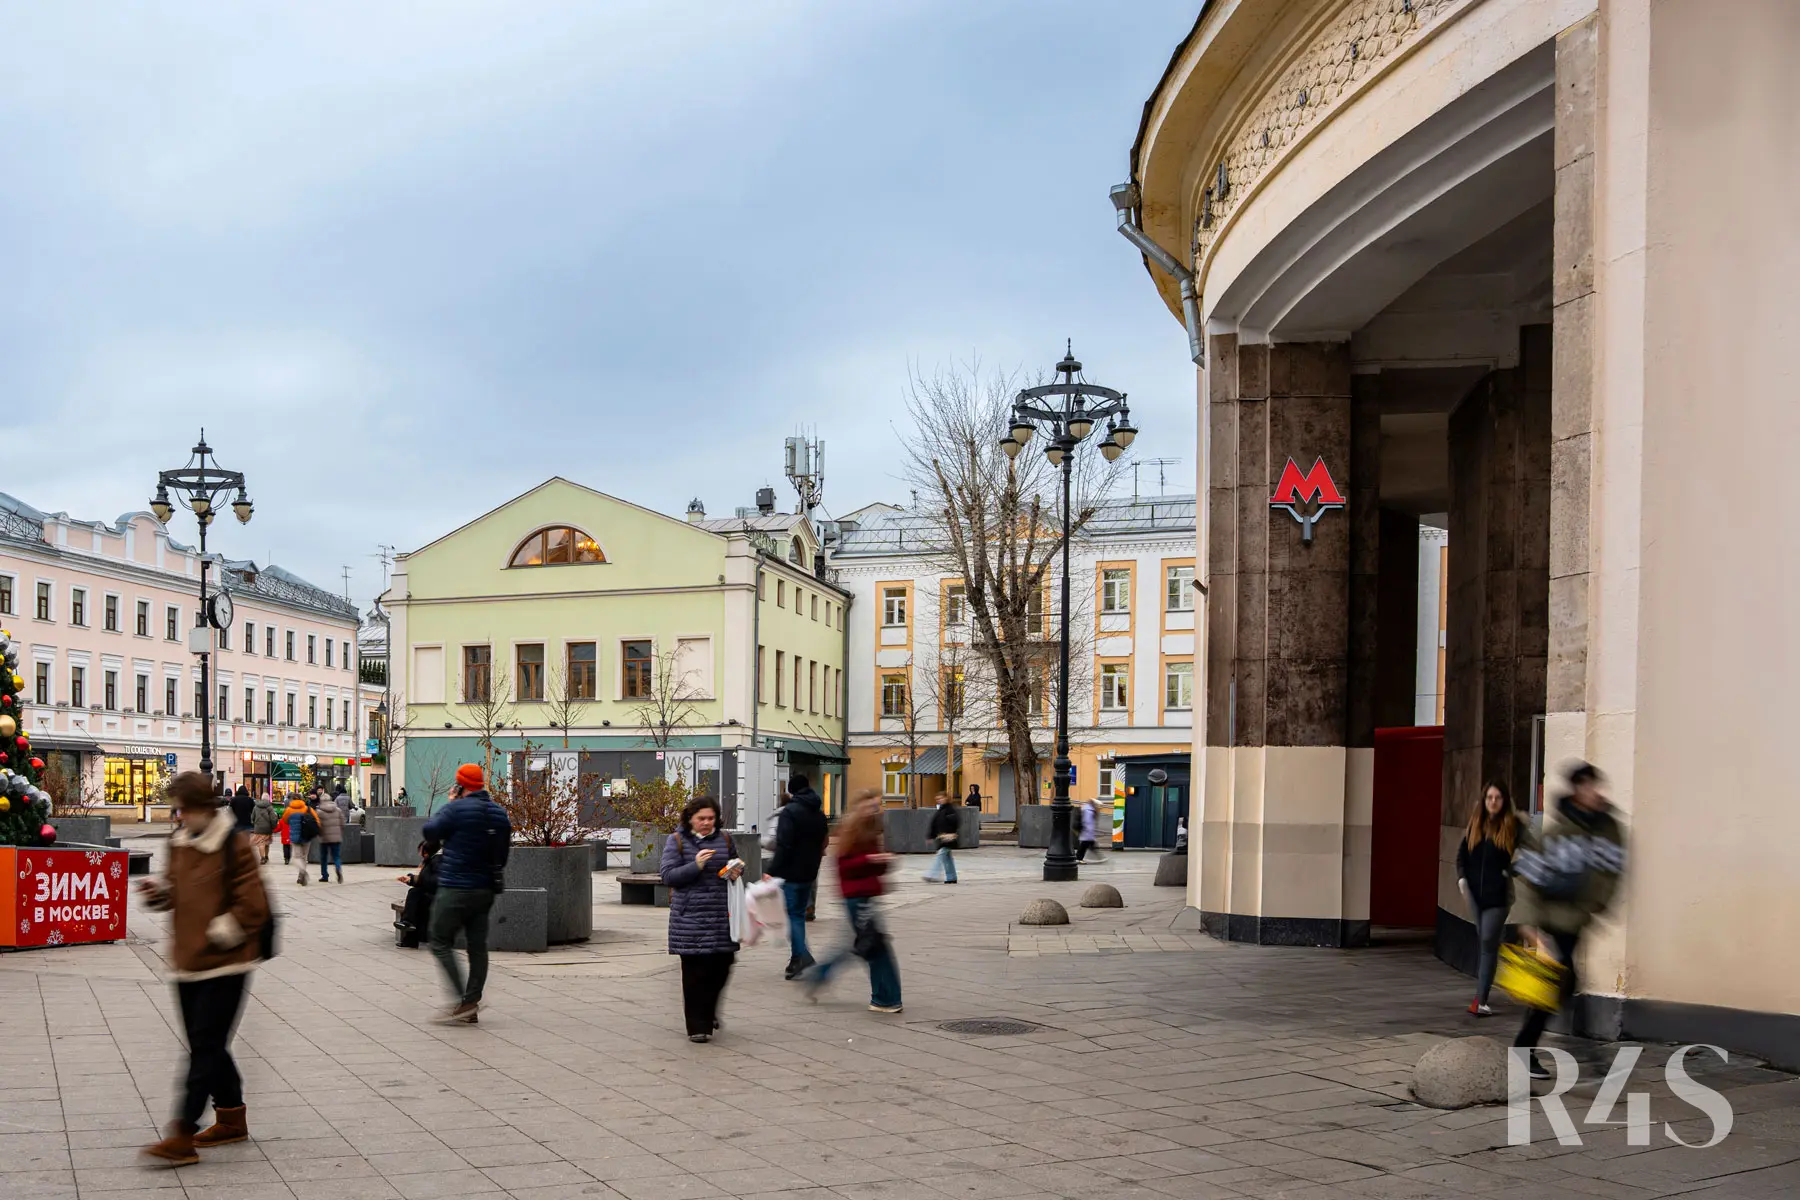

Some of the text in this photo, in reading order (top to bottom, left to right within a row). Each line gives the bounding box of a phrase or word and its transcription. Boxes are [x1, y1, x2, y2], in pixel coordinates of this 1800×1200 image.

[1269, 456, 1346, 504] М
[131, 746, 161, 755] COLLECTION
[553, 756, 578, 771] WC
[667, 755, 693, 771] WC
[34, 872, 110, 902] ЗИМА
[34, 904, 110, 923] В МОСКВЕ
